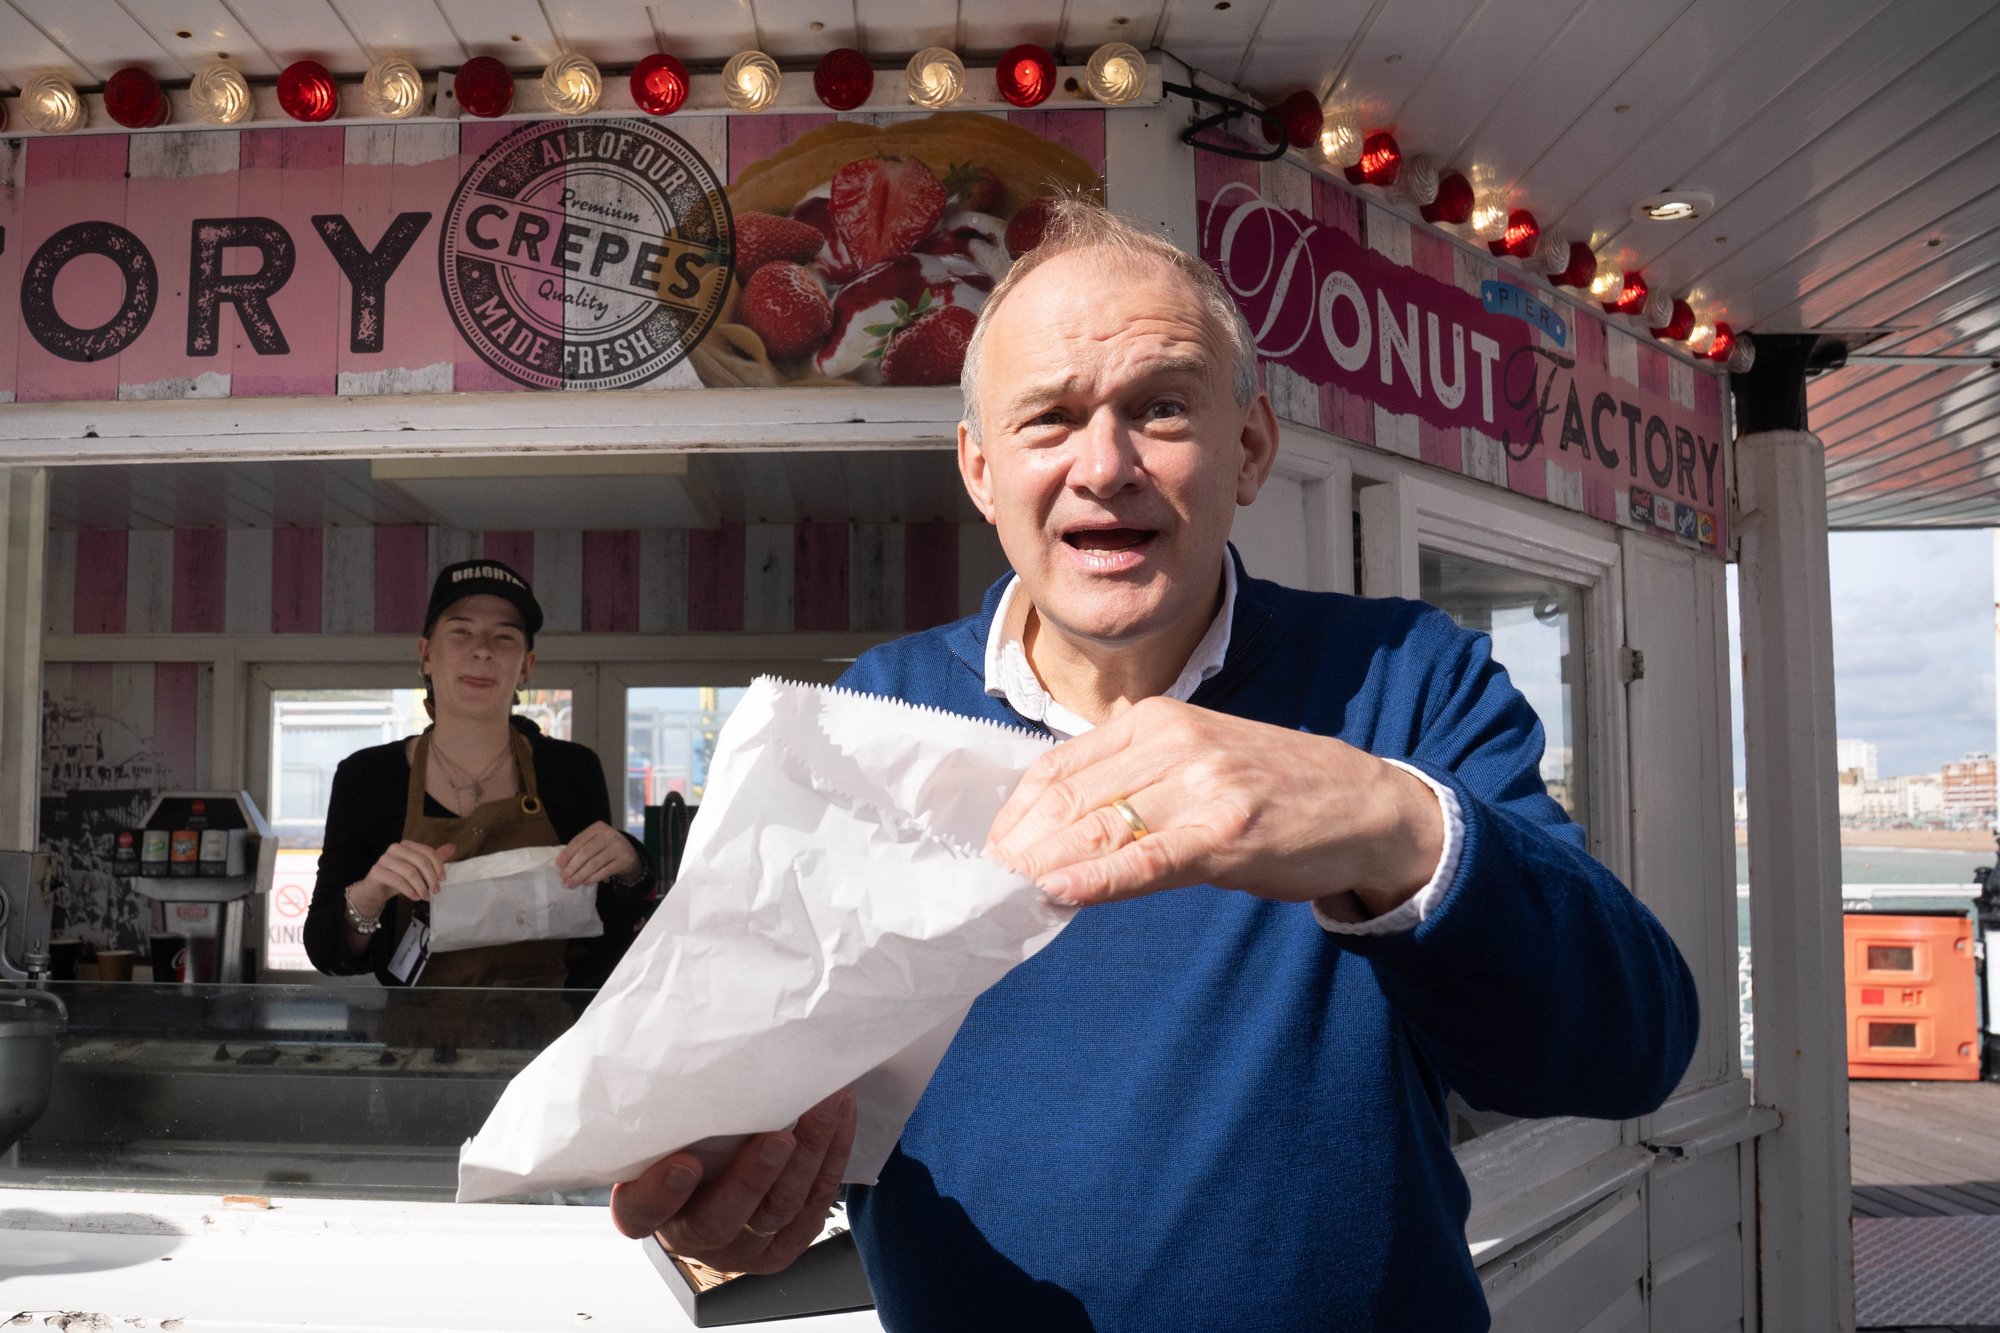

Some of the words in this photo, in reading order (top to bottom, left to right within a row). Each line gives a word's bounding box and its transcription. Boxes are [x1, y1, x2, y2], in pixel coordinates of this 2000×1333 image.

[541, 130, 593, 168] ALL
[598, 130, 633, 160] OF
[632, 143, 688, 195] OUR
[557, 187, 640, 224] Premium
[0, 211, 433, 363] ORY
[465, 203, 707, 299] CREPES
[474, 295, 549, 367] MADE
[558, 328, 657, 375] FRESH
[538, 278, 610, 321] Quality
[1204, 182, 1500, 424] DONUT
[1498, 287, 1550, 329] PIER
[1503, 345, 1719, 507] FACTORY
